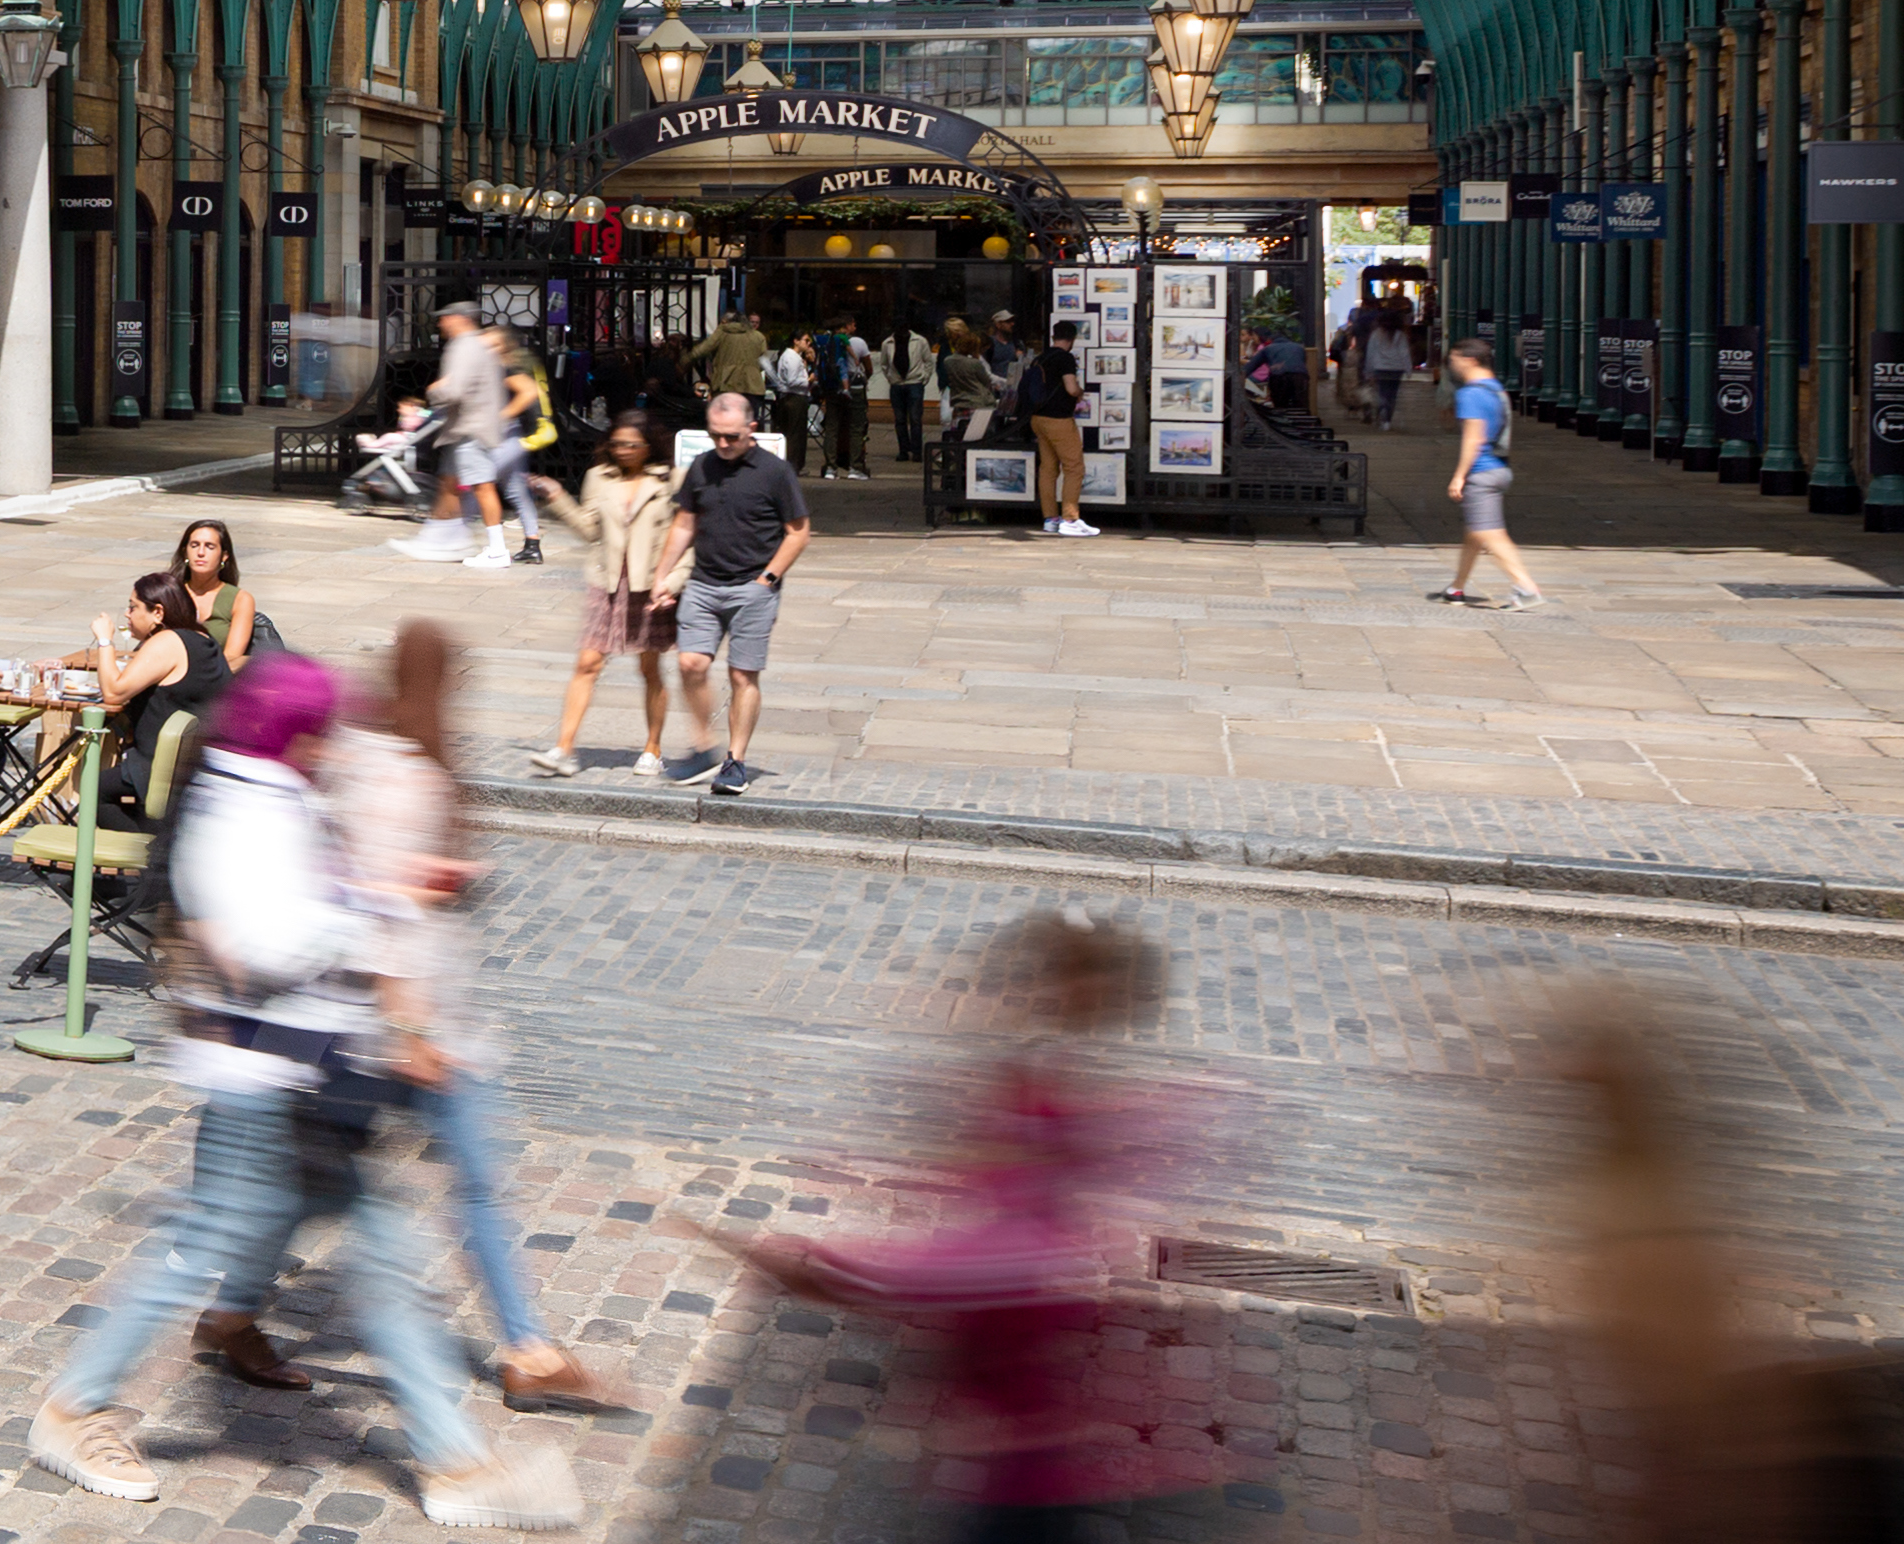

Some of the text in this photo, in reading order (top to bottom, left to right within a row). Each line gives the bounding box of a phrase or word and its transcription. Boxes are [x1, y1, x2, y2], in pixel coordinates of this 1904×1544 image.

[657, 99, 937, 142] APPLE MARKET
[1020, 136, 1056, 145] HALL
[819, 168, 1016, 196] APPLE MARKET
[1819, 178, 1898, 186] HAWKERS
[59, 198, 112, 208] TOM FORD
[1607, 216, 1661, 226] Whittard
[1556, 222, 1601, 231] Whittar
[117, 321, 142, 330] STOP
[271, 320, 289, 328] STOP
[1522, 329, 1545, 337] STOP
[1599, 337, 1621, 345] STO
[1623, 339, 1654, 348] STOP
[1718, 349, 1753, 360] STOP
[1873, 362, 1904, 375] STO
